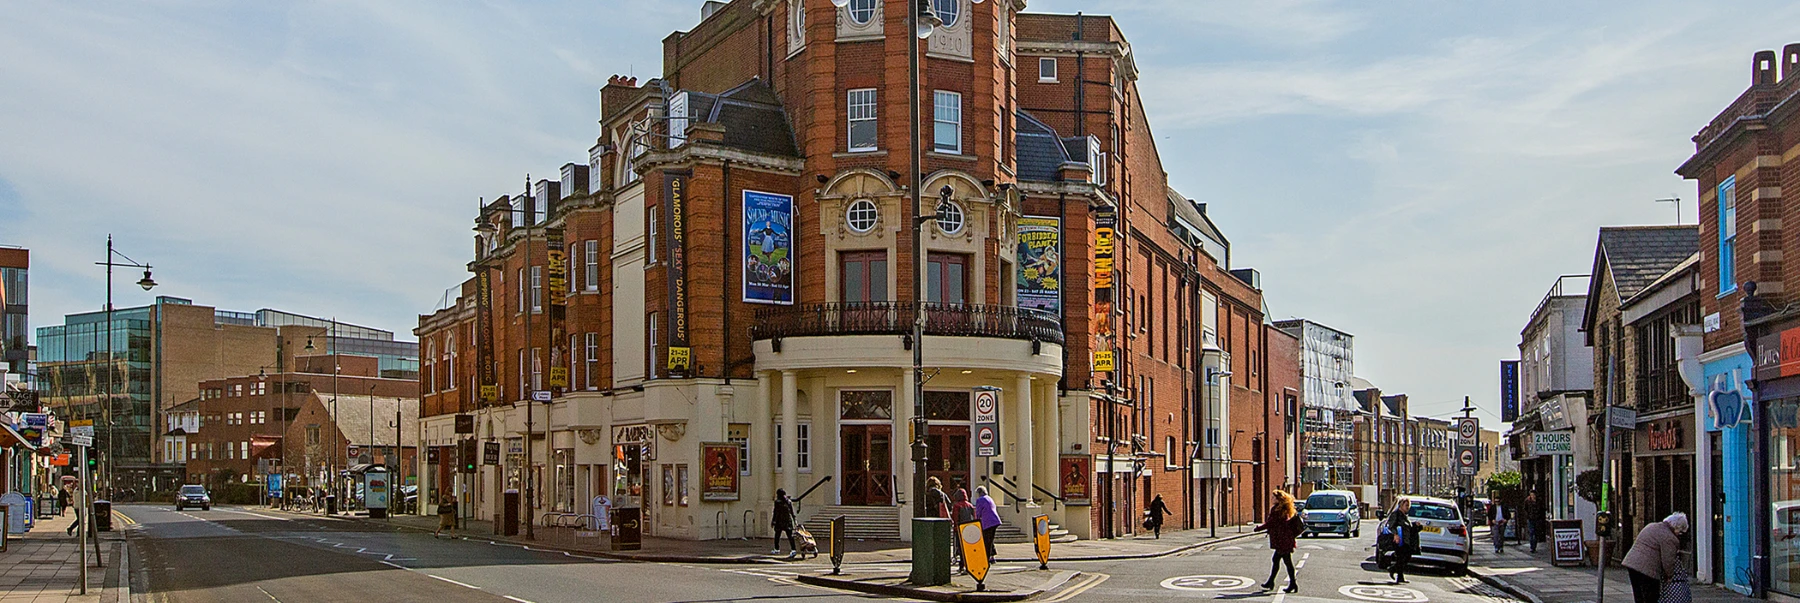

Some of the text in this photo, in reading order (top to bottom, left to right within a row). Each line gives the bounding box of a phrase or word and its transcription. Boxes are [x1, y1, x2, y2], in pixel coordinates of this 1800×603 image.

[934, 34, 962, 52] 1910
[672, 178, 681, 242] 'GLAMOROUS'
[747, 208, 767, 224] SOUND
[771, 209, 790, 229] MUSIC
[1017, 231, 1058, 244] FORBIDDEN
[1028, 240, 1058, 249] PLANET
[676, 277, 684, 341] 'DANGEROUS'
[1782, 339, 1789, 361] &
[980, 399, 991, 407] 20
[1463, 425, 1473, 433] 20
[1536, 434, 1571, 442] 2 HOURS
[1536, 443, 1571, 451] DRY CLEANING
[1175, 579, 1241, 587] 20
